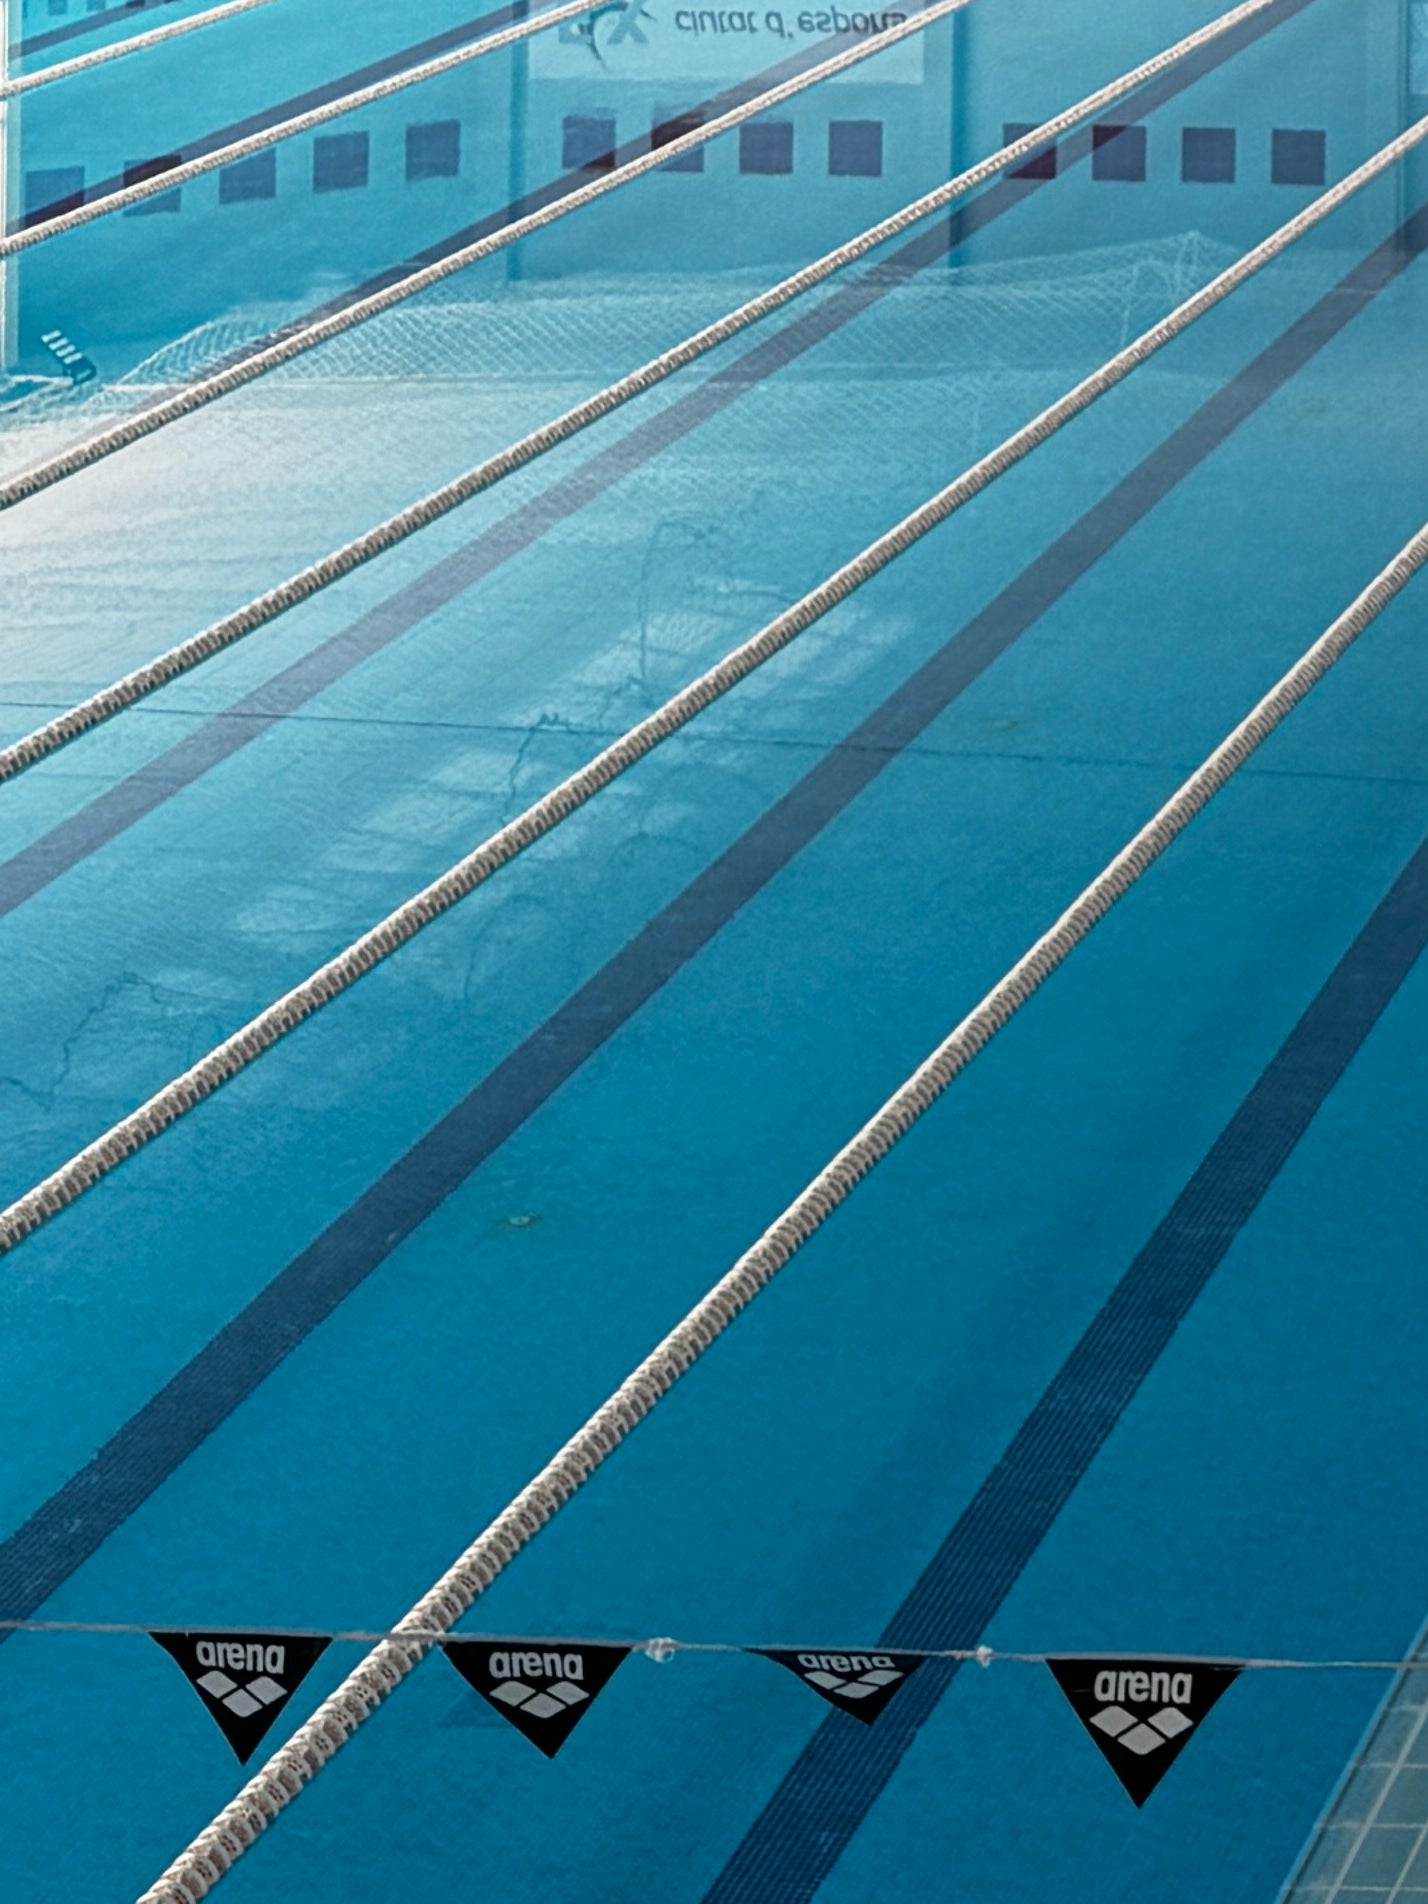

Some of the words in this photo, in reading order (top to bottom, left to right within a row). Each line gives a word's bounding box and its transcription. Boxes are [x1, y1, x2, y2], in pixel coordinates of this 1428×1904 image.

[195, 1640, 285, 1674] arena
[489, 1651, 585, 1680] arena
[797, 1653, 896, 1672] arena
[1094, 1670, 1193, 1704] arena
